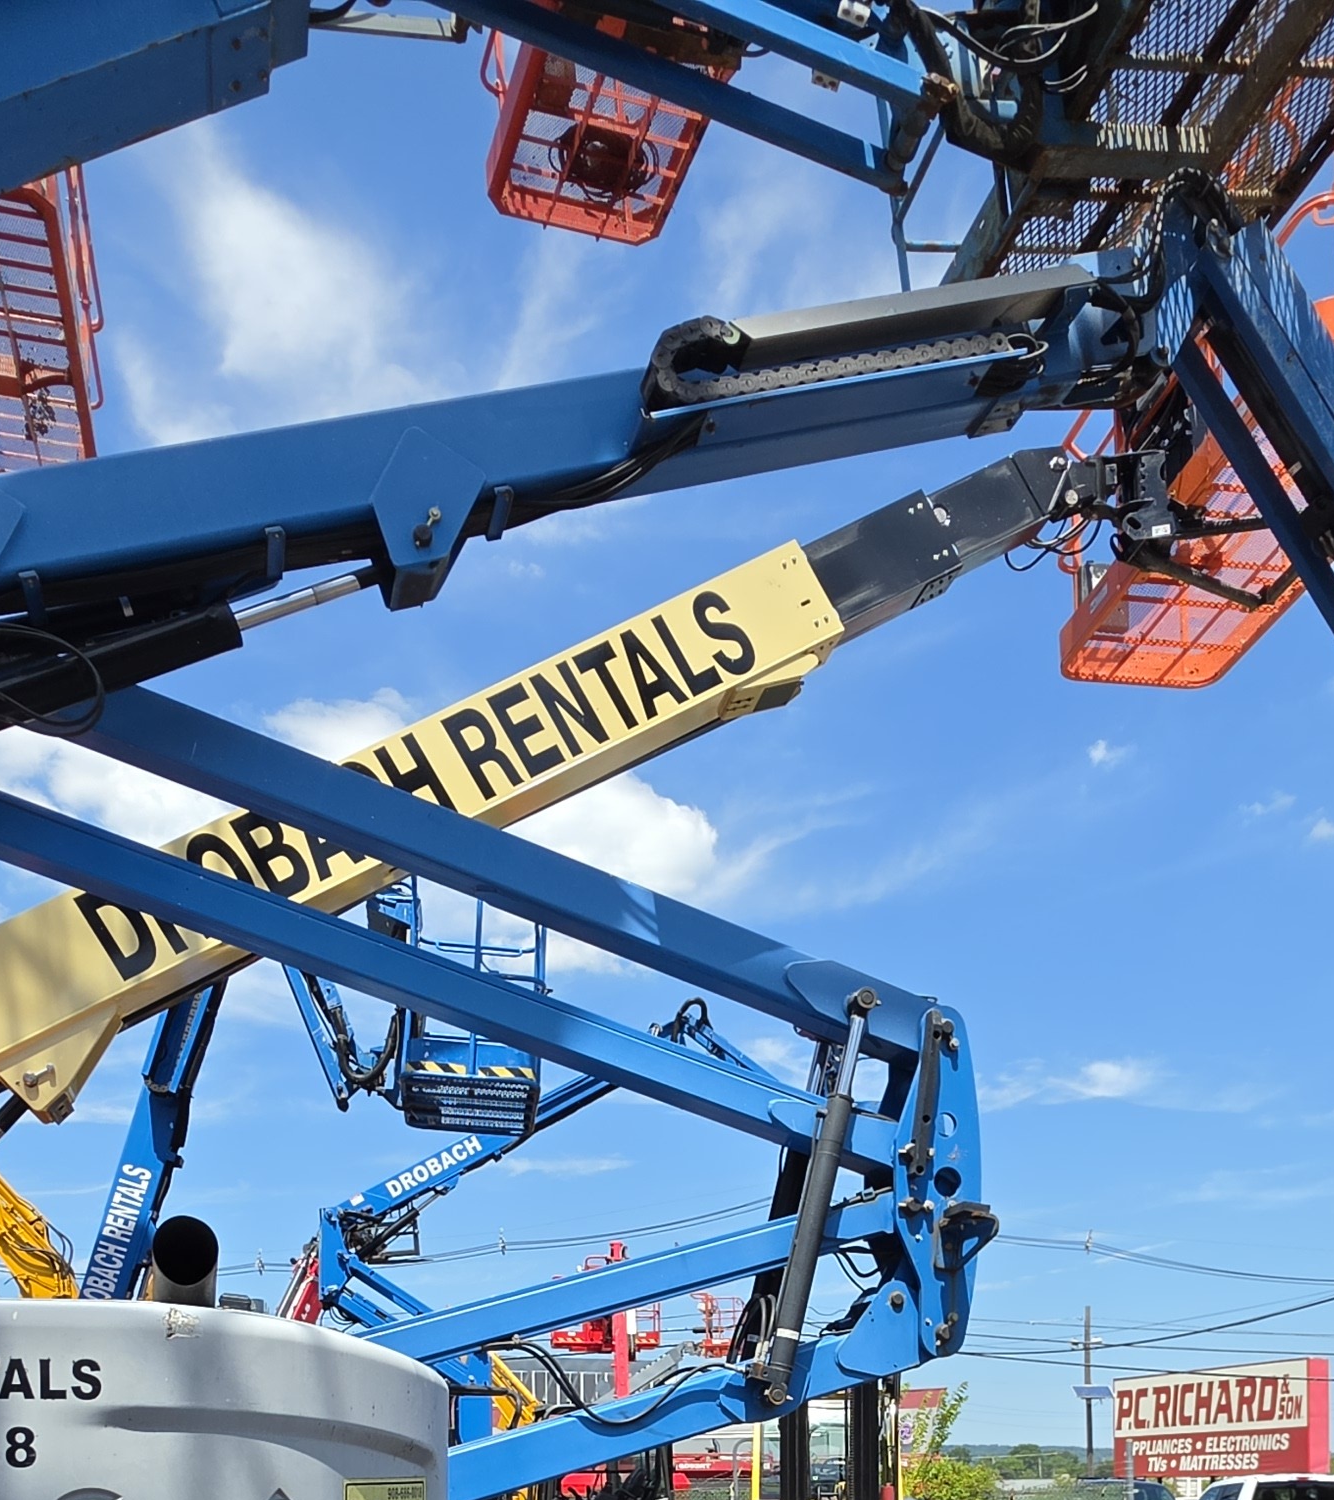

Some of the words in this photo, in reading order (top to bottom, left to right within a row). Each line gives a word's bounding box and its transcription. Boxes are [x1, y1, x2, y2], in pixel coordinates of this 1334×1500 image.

[440, 590, 756, 800] RENTALS
[384, 1134, 483, 1199] DROBACH
[103, 1163, 152, 1242] RENTALS
[1153, 1375, 1278, 1429] RICHARD
[1280, 1373, 1290, 1395] &
[1278, 1395, 1303, 1420] SON
[1124, 1437, 1193, 1457] PPLIANCES
[1205, 1433, 1290, 1453] ELECTRONICS
[1147, 1457, 1168, 1472] TVs
[1179, 1453, 1259, 1471] MATTRESSES
